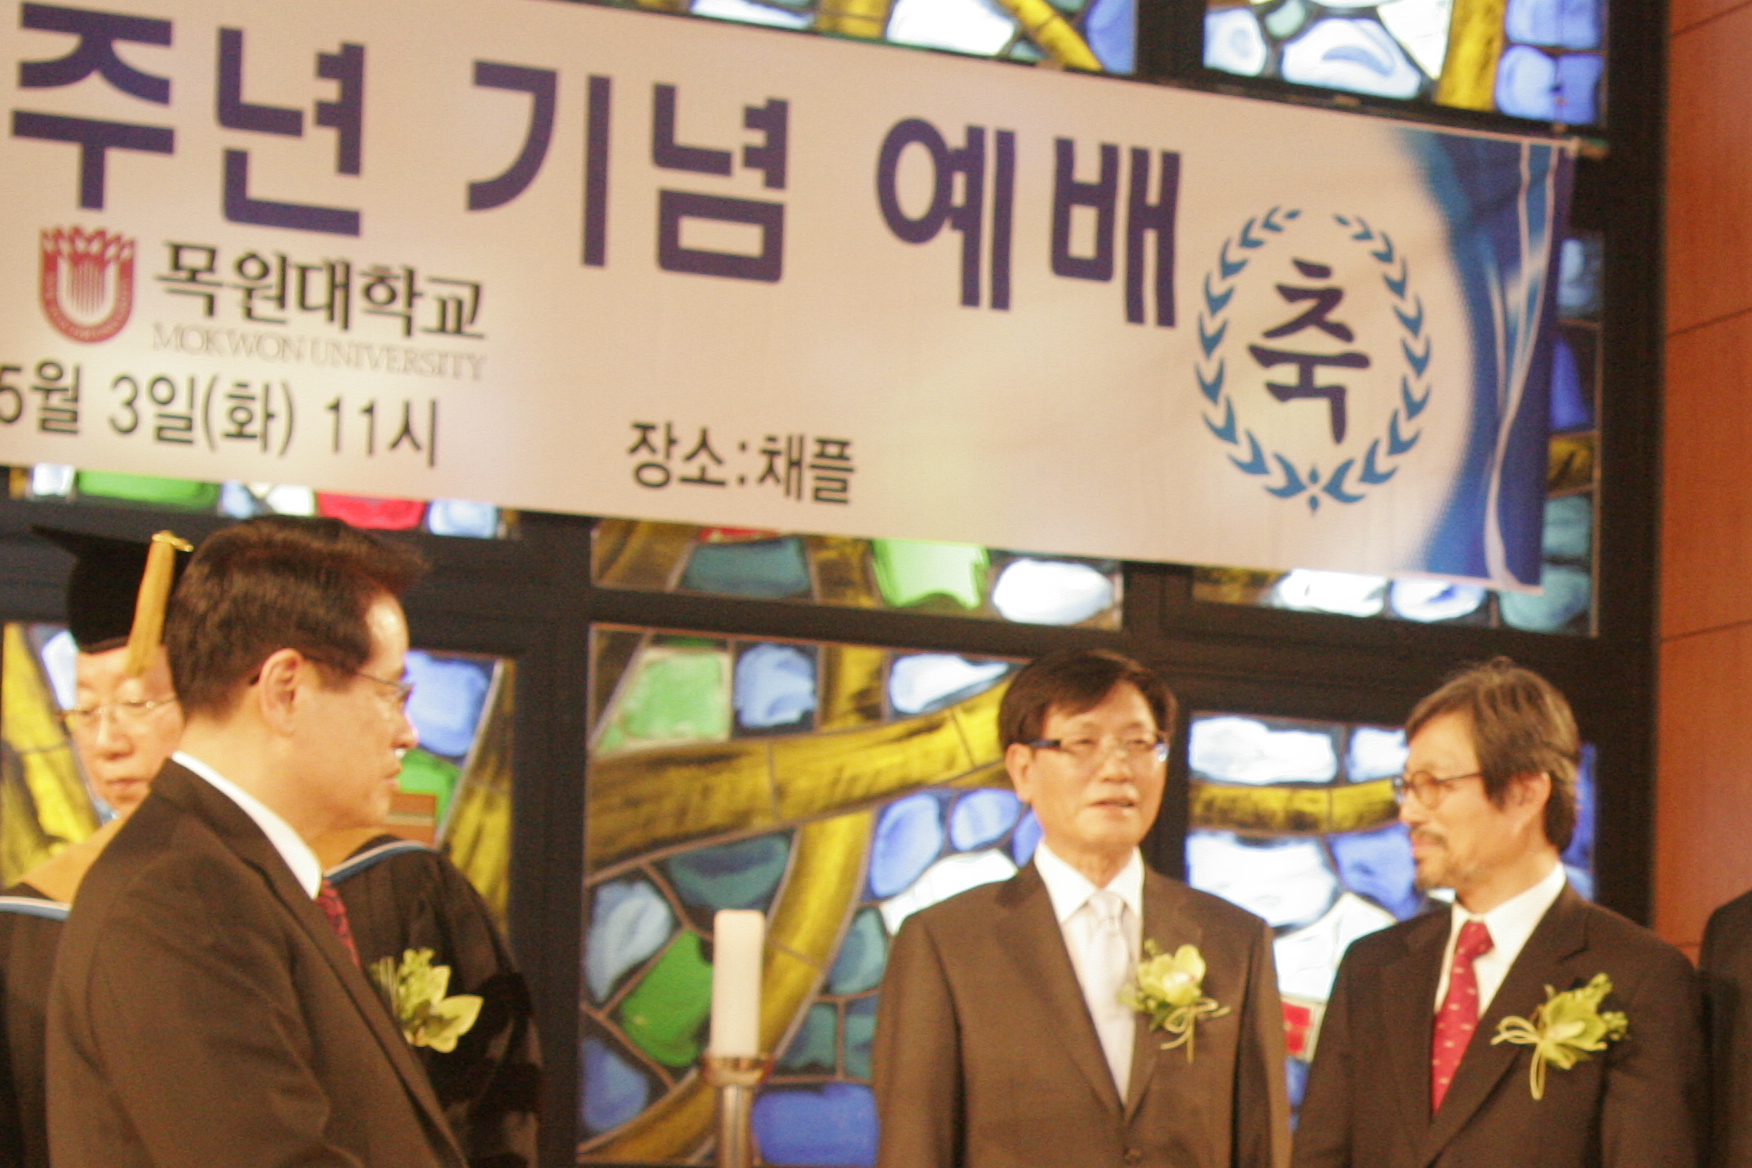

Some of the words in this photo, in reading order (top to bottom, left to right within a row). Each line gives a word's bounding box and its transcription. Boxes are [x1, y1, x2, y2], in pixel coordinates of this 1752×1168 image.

[9, 1, 367, 237] 주년
[466, 60, 790, 283] 기념
[875, 117, 1181, 328] 예배
[155, 241, 485, 340] 목원대학교
[152, 322, 303, 362] MOKWON
[309, 336, 487, 382] UNIVERSITY
[1248, 258, 1371, 444] 축
[0, 360, 80, 435] 5월
[109, 373, 295, 456] 3일(화)
[326, 397, 438, 468] 11시
[628, 420, 856, 506] 장소:채플
